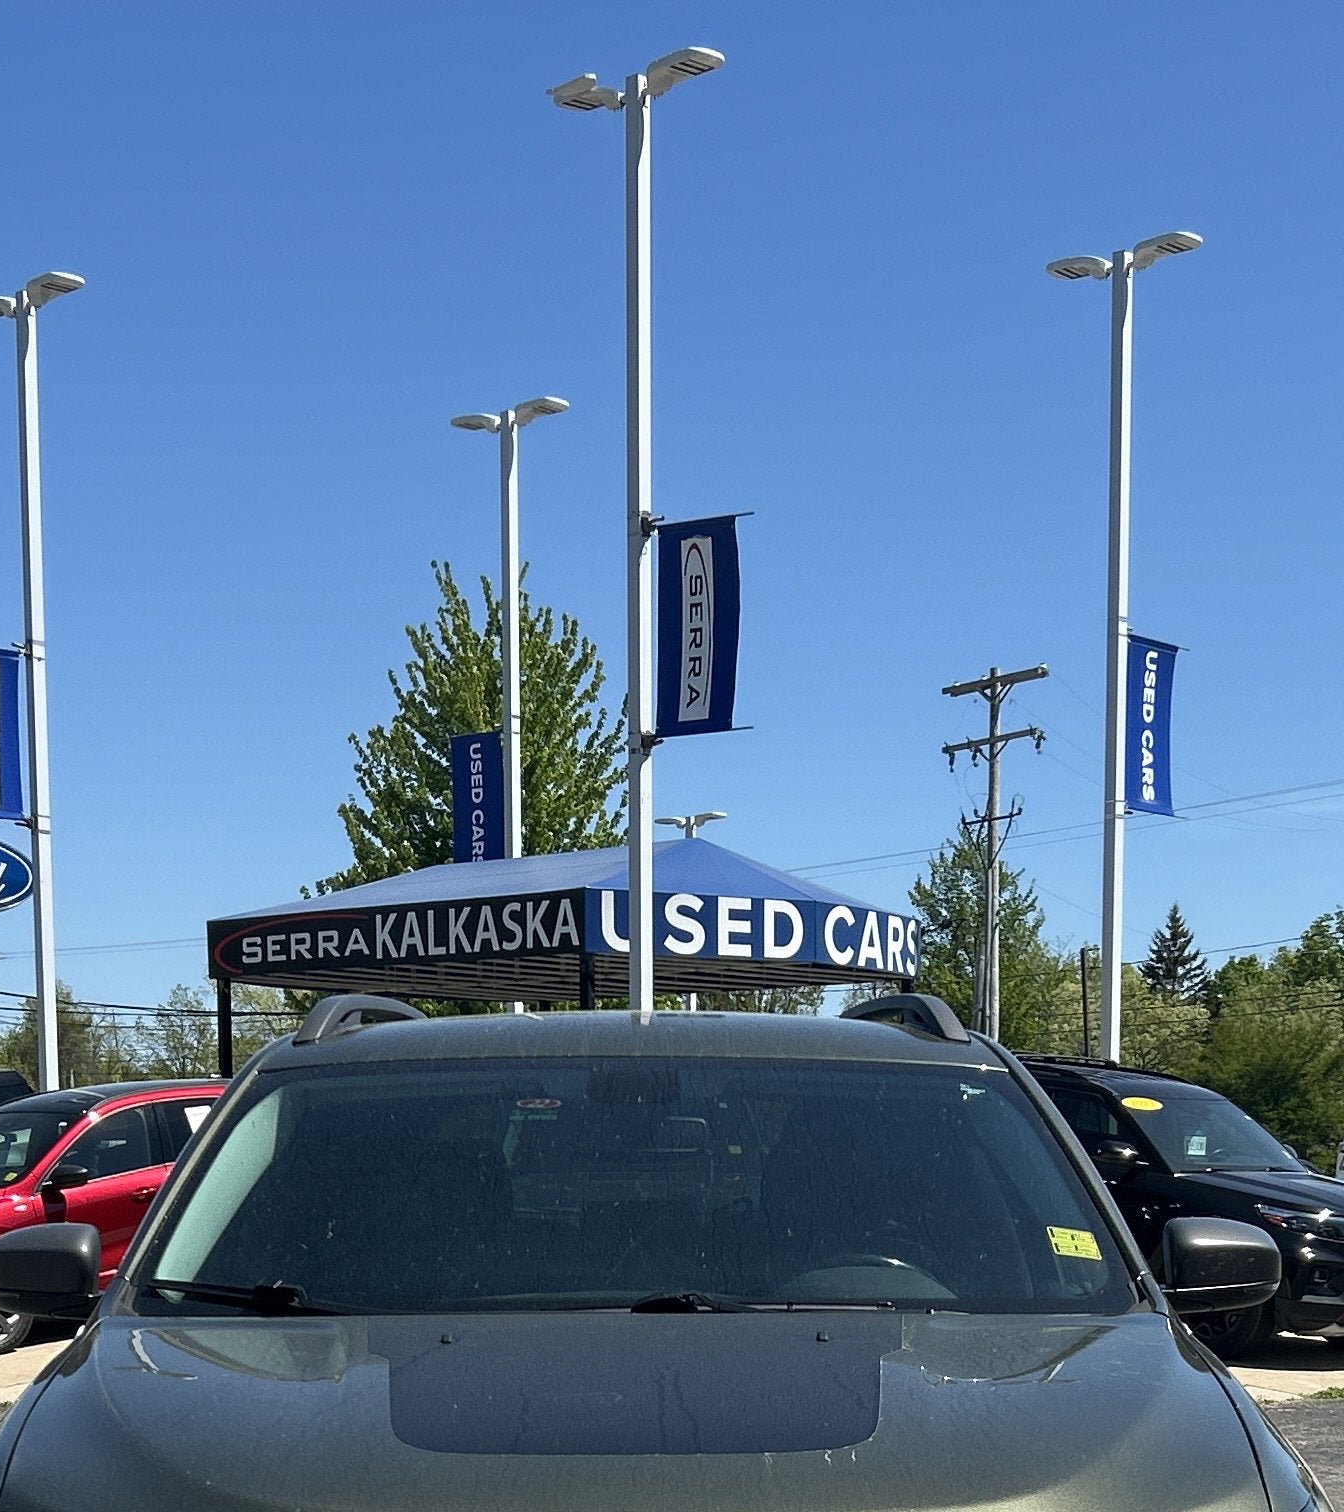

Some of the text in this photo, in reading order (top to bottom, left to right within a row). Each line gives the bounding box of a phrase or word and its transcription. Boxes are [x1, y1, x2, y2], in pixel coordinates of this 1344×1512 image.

[687, 575, 703, 708] SERRA
[1142, 651, 1158, 801] USED CARS
[470, 743, 484, 803] USED
[242, 898, 580, 964] SERRA KALKASKA
[601, 890, 916, 977] USED CARS
